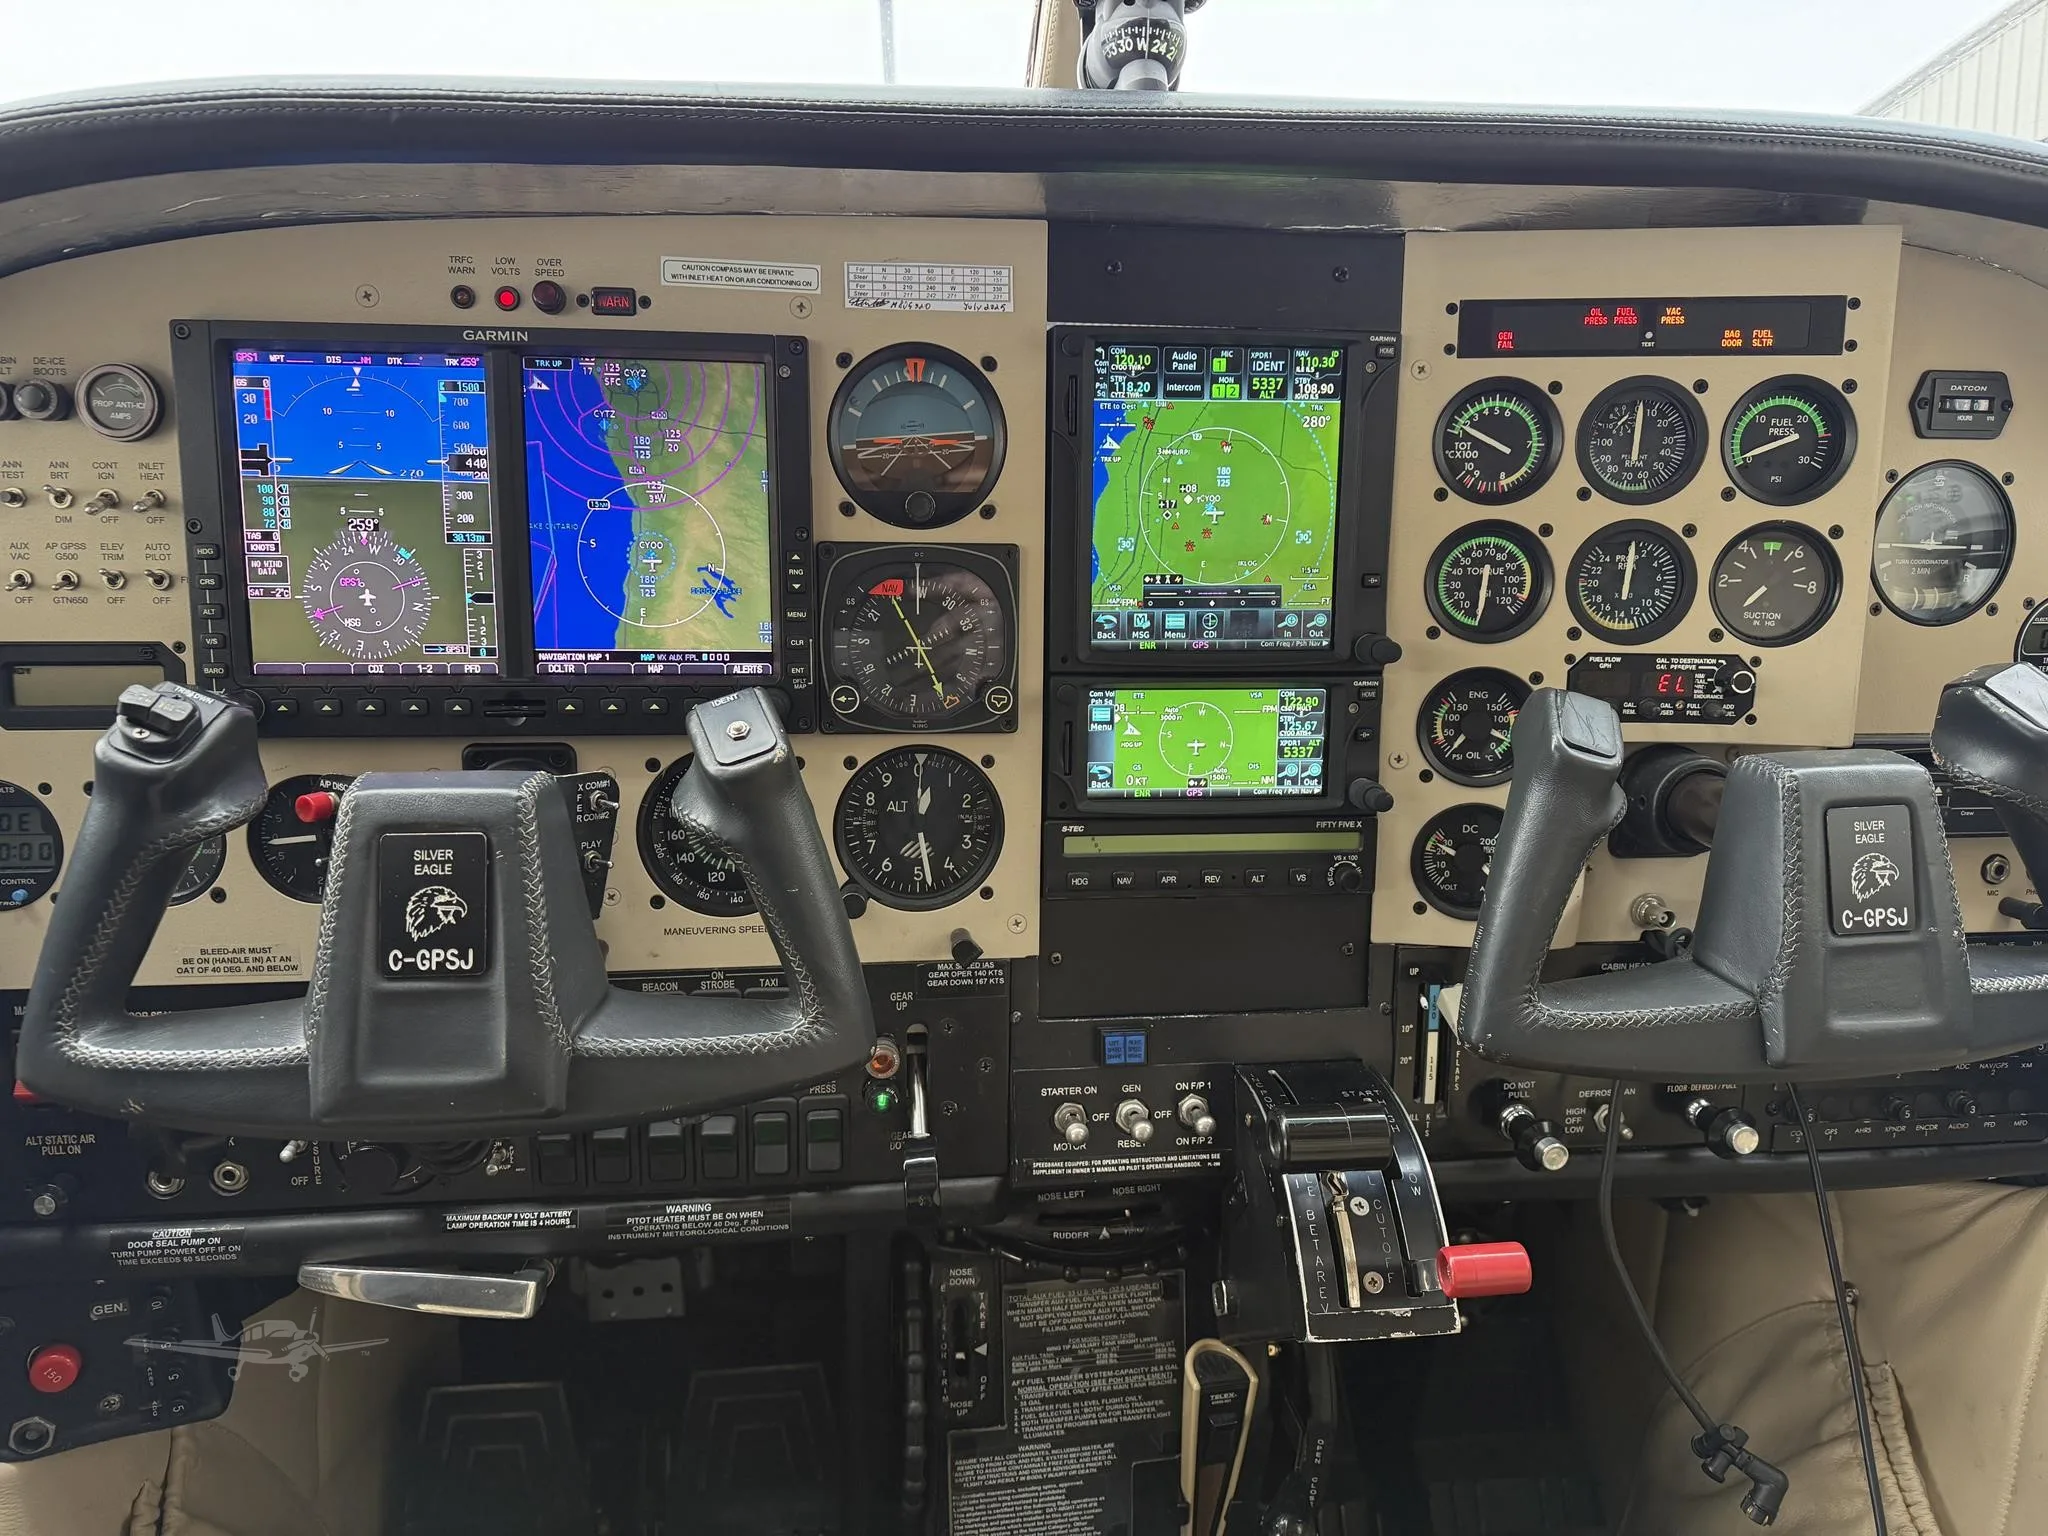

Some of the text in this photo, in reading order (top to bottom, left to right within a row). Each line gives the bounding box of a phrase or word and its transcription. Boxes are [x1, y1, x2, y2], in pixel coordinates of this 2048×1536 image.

[1118, 38, 1167, 55] 30 W 24
[449, 256, 473, 264] TRFC
[495, 257, 516, 265] LOW
[537, 258, 562, 267] OVER
[448, 266, 476, 274] WARN
[491, 267, 521, 275] VOLTS
[534, 268, 564, 277] SPEED
[711, 265, 742, 273] COMPASS
[598, 296, 629, 308] WARN
[1590, 308, 1603, 316] OIL
[1616, 307, 1636, 316] FUEL
[1666, 307, 1681, 315] VAC
[1584, 316, 1608, 325] PRESS
[1613, 315, 1638, 325] PRESS
[1661, 315, 1685, 325] PRESS
[463, 330, 528, 342] GARMIN
[1498, 331, 1513, 340] GEN
[1724, 330, 1741, 338] BAG
[1752, 330, 1773, 338] FUEL
[1497, 340, 1514, 349] FAIL
[1721, 339, 1742, 348] DOOR
[1752, 338, 1773, 347] SLTR
[33, 357, 65, 365] DE-ICE
[1114, 354, 1151, 366] 120.10
[1172, 351, 1197, 362] Audio
[445, 357, 480, 366] TRK 259°
[1299, 356, 1336, 368] 110.30
[1172, 362, 1197, 372] Panel
[1252, 361, 1285, 372] IDENT
[624, 368, 646, 378] CYYZ
[1114, 381, 1150, 393] 118.20
[1166, 383, 1201, 392] Intercom
[1252, 378, 1283, 390] 5337
[1298, 383, 1334, 394] 108.90
[1302, 416, 1331, 428] 280°
[1771, 418, 1793, 426] FUEL
[1455, 442, 1471, 450] TOT
[138, 462, 165, 470] INLET
[98, 472, 114, 480] IGN
[102, 553, 124, 561] TRIM
[146, 553, 171, 561] PILOT
[788, 568, 804, 576] RNG
[1744, 611, 1781, 620] SUCTION
[1097, 631, 1116, 639] Back
[1132, 631, 1150, 639] MSG
[1164, 630, 1186, 639] Menu
[368, 665, 384, 673] CDI
[464, 665, 480, 673] PFD
[733, 664, 763, 674] ALERTS
[1469, 691, 1489, 699] ENG
[1284, 721, 1317, 731] 125.67
[1284, 747, 1313, 758] 5337
[1466, 752, 1481, 760] OIL
[1316, 820, 1362, 829] FIFTY FIVE X
[1462, 825, 1478, 833] DC
[1854, 821, 1885, 831] SILVER
[1855, 833, 1885, 844] EAGLE
[414, 850, 454, 861] SILVER
[414, 864, 452, 875] EAGLE
[1071, 876, 1089, 885] HDG
[1117, 876, 1132, 885] NAV
[1161, 875, 1177, 883] APR
[1205, 874, 1221, 883] REV
[1251, 874, 1265, 883] ALT
[1296, 873, 1306, 882] VS
[1842, 908, 1909, 929] C-GPSJ
[664, 927, 736, 935] MANEUVERING
[211, 956, 249, 965] (HANDLE
[251, 956, 265, 965] IN)
[388, 949, 474, 971] C-GPSJ
[246, 965, 263, 973] AND
[266, 964, 298, 972] BELOW
[1410, 968, 1419, 976] UP
[642, 983, 678, 991] BEACON
[701, 981, 735, 989] STROBE
[760, 979, 778, 987] TAXI
[927, 979, 948, 987] GEAR
[890, 992, 913, 1001] GEAR
[896, 1002, 908, 1010] UP
[1122, 1084, 1141, 1092] GEN
[1175, 1081, 1212, 1090] ON F/P 1
[1041, 1086, 1097, 1096] STARTER ON
[1154, 1111, 1172, 1119] OFF
[1566, 1108, 1586, 1116] HIGH
[1092, 1113, 1110, 1122] OFF
[1565, 1126, 1584, 1134] LOW
[26, 1134, 96, 1145] ALT STATIC AIR
[42, 1145, 81, 1155] PULL ON
[666, 1204, 712, 1214] WARNING
[152, 1230, 192, 1239] CAUTION
[181, 1238, 205, 1246] PUMP
[92, 1303, 127, 1317] GEN.
